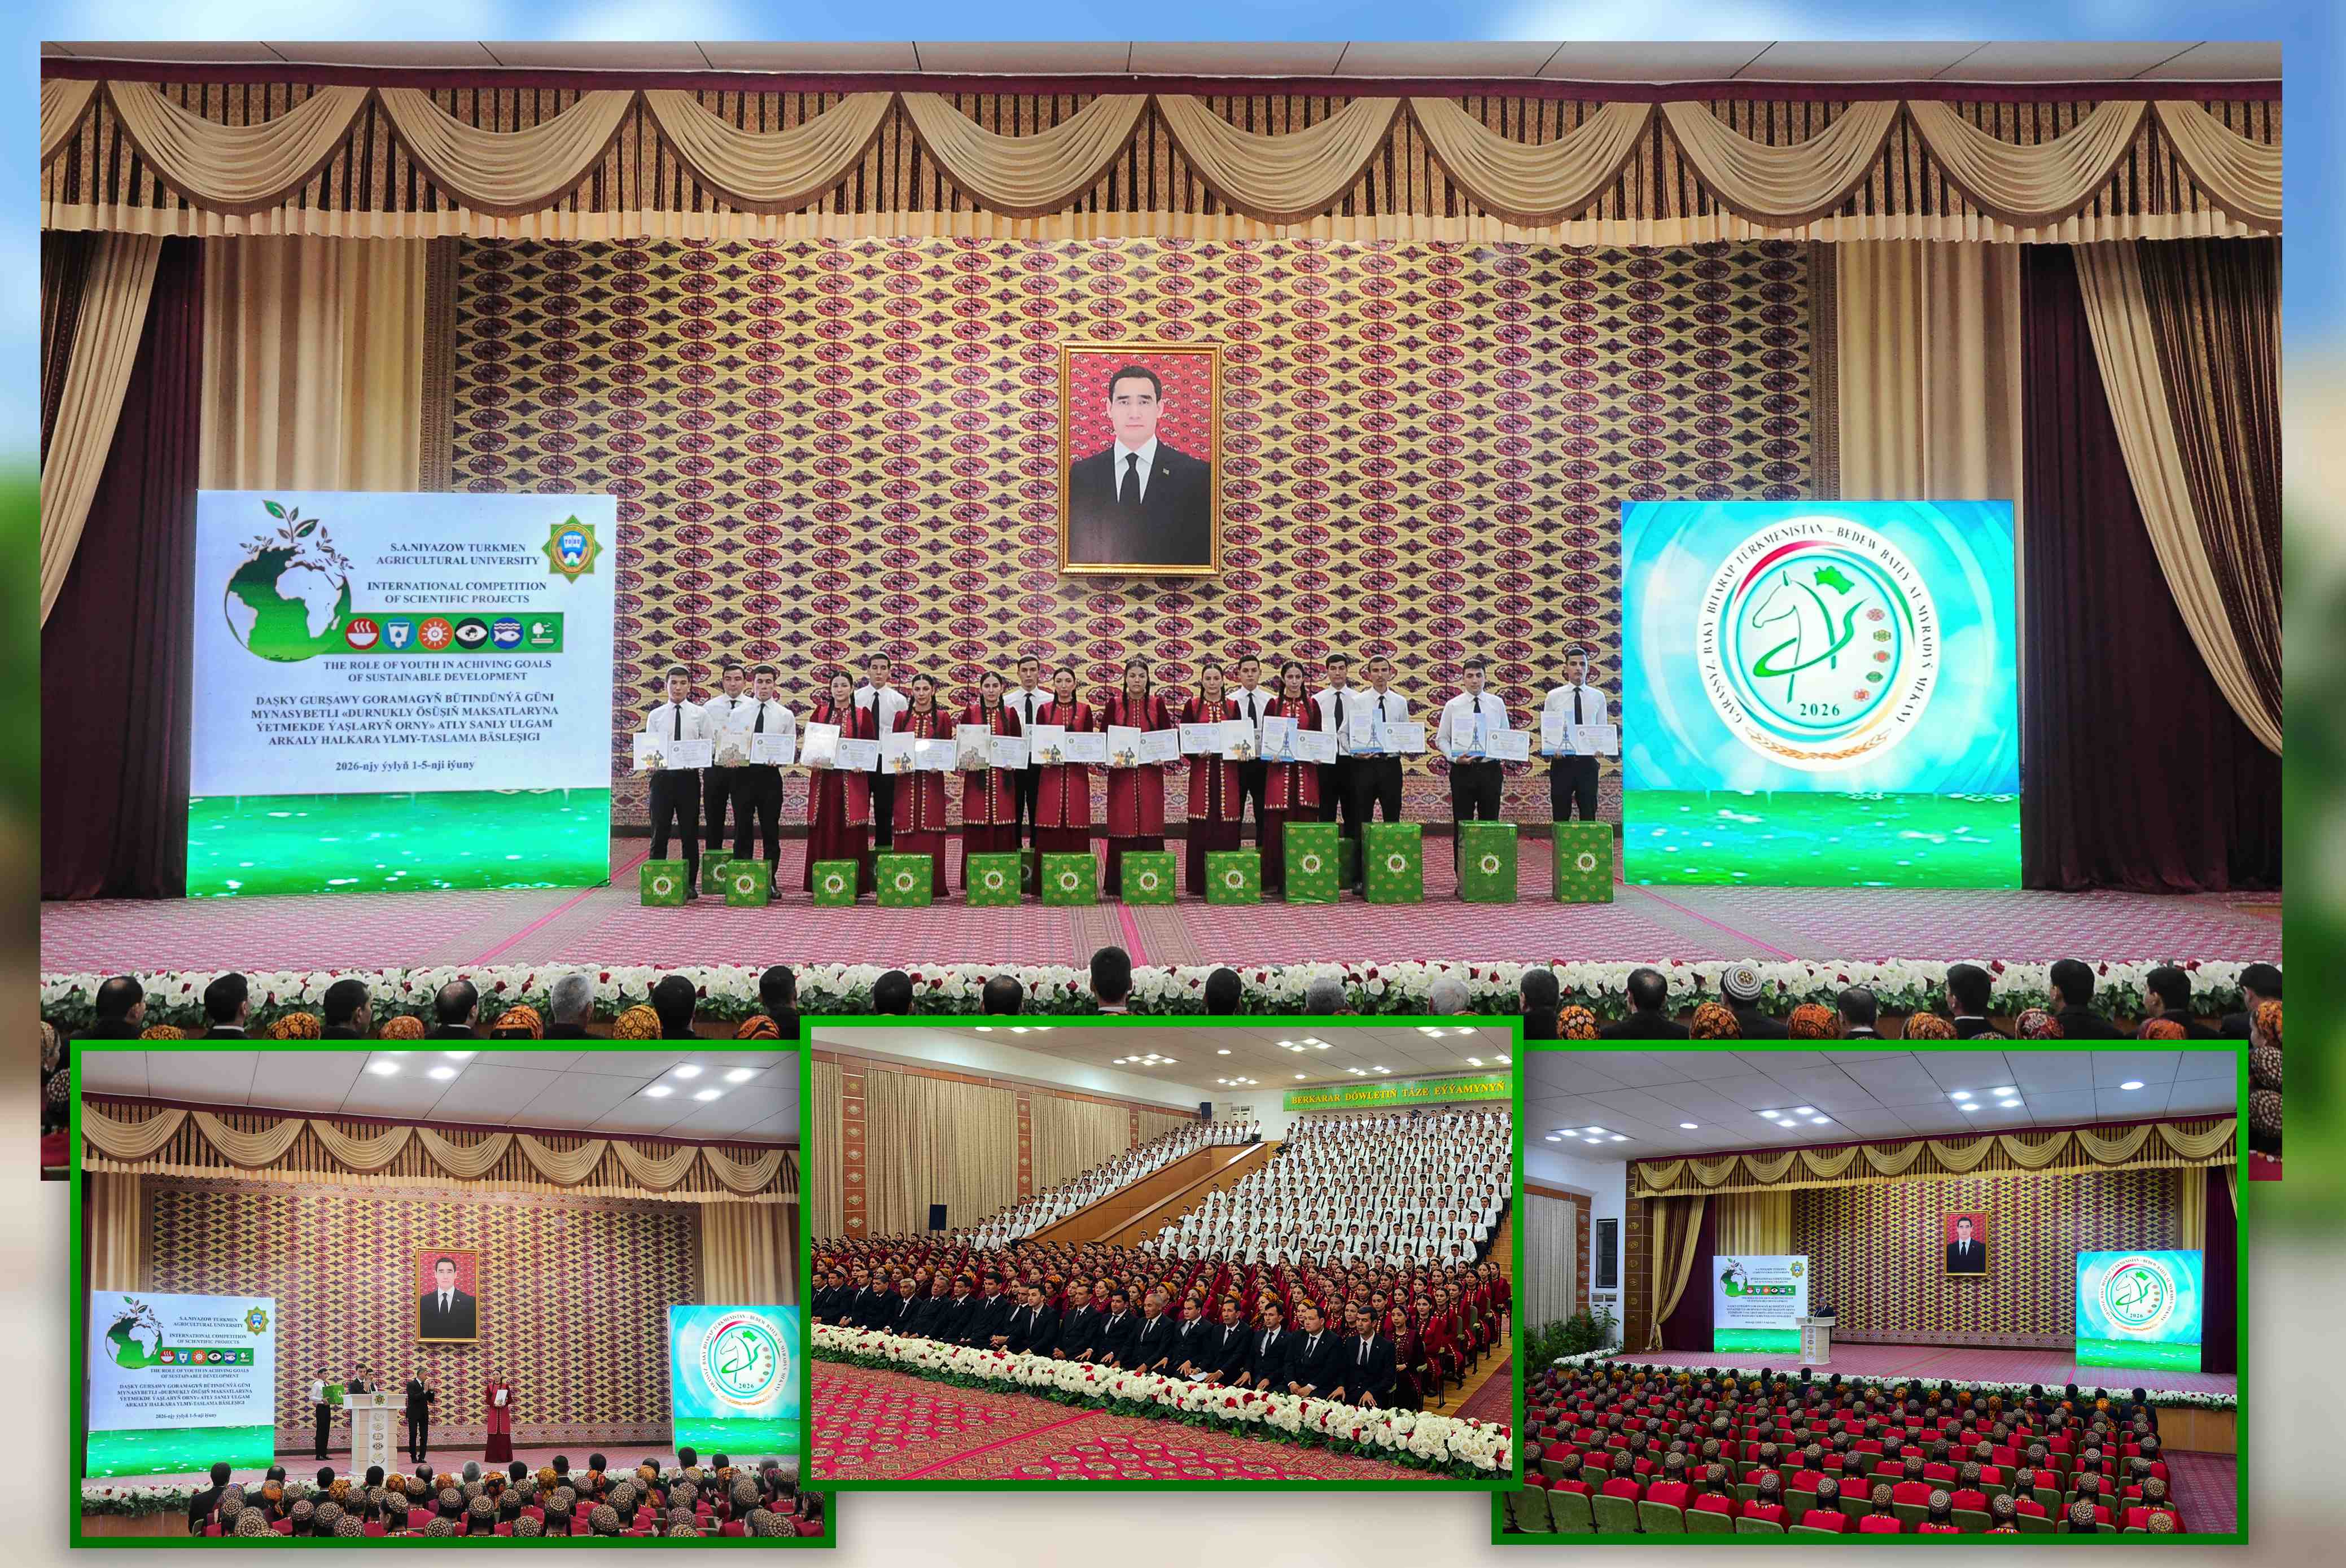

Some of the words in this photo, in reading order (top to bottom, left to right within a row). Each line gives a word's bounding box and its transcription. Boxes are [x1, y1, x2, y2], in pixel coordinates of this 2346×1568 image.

[1837, 527, 1876, 549] BEDEW
[390, 543, 466, 552] S.A.NIYAZOW
[468, 543, 526, 552] TURKMEN
[376, 556, 469, 565] AGRICULTURAL
[470, 556, 540, 565] UNIVERSITY
[1880, 549, 1912, 581] BATLY
[367, 581, 463, 590] INTERNATIONAL
[466, 581, 547, 590] COMPETITION
[1706, 564, 1735, 614] BITARAP
[385, 594, 401, 603] OF
[403, 594, 469, 603] SCIENTIFIC
[472, 594, 529, 603] PROJECTS
[1703, 621, 1713, 653] BAKY
[323, 661, 347, 670] THE
[349, 660, 380, 669] ROLE
[383, 660, 398, 669] OF
[400, 660, 440, 669] YOUTH
[455, 660, 512, 668] ACHIVING
[514, 659, 552, 668] GOALS
[348, 673, 364, 682] OF
[365, 673, 442, 682] SUSTAINABLE
[444, 672, 528, 681] DEVELOPMENT
[256, 696, 297, 707] DAŞKY
[300, 695, 360, 706] GURŞAWY
[362, 693, 442, 704] GORAMAGYŇ
[525, 693, 554, 702] GÜNI
[251, 709, 339, 719] MYNASYBETLI
[342, 708, 413, 717] «DURNUKLY
[416, 706, 458, 717] ÖSÜŞIŇ
[462, 706, 559, 716] MAKSATLARYNA
[1800, 703, 1840, 716] 2026
[256, 721, 325, 732] ÝETMEKDE
[329, 719, 392, 733] ÝAŞLARYŇ
[395, 721, 435, 730] ORNY»
[437, 720, 467, 729] ATLY
[469, 720, 507, 729] SANLY
[510, 719, 553, 728] ULGAM
[268, 735, 319, 746] ARKALY
[321, 735, 380, 744] HALKARA
[382, 734, 477, 743] YLMY-TASLAMA
[480, 731, 540, 743] BÄSLEŞIGI
[335, 762, 379, 772] 2026-njy
[382, 761, 409, 772] ýylyň
[413, 760, 445, 771] 1-5-nji
[447, 760, 475, 770] iýuny
[1291, 1093, 1341, 1105] BERKARAR
[1434, 1080, 1505, 1095] EÝÝAMYNYŇ
